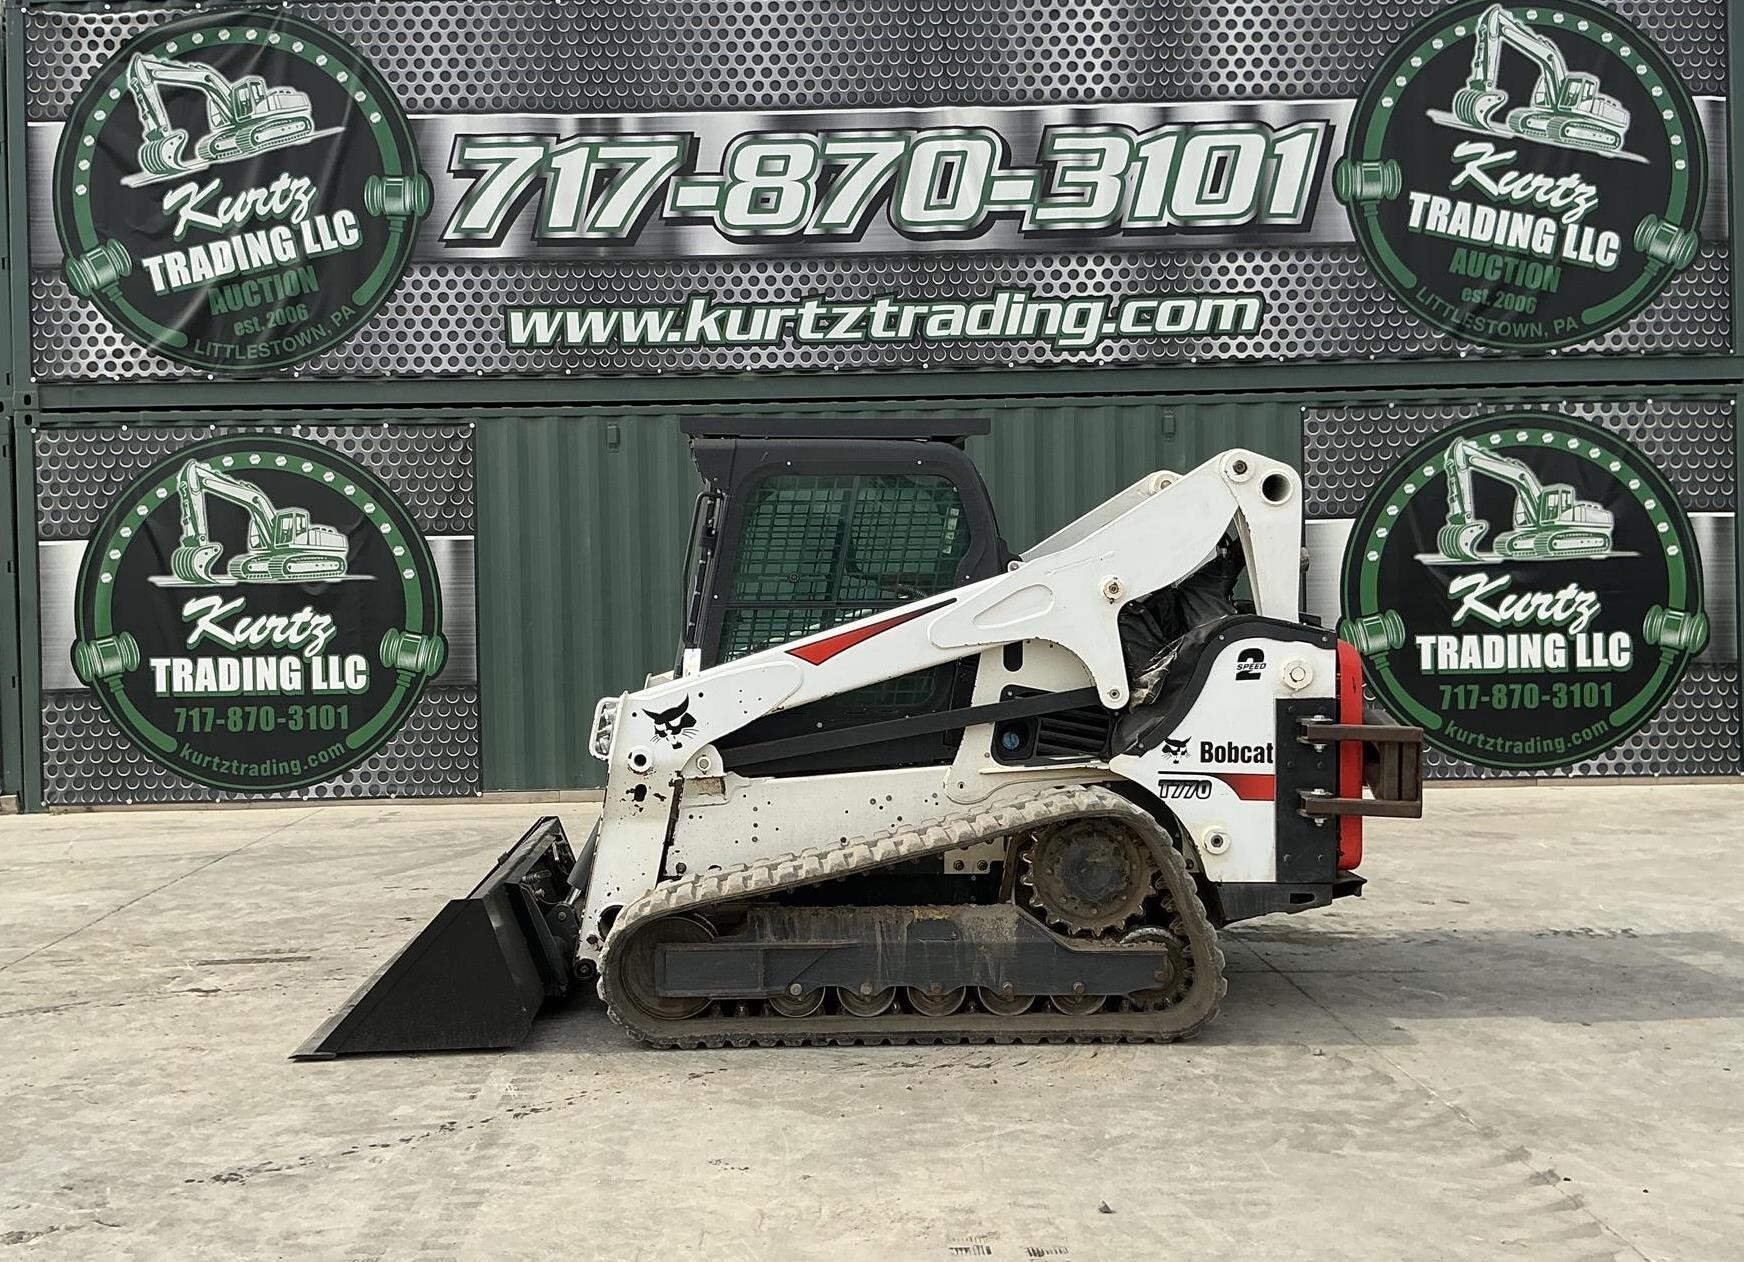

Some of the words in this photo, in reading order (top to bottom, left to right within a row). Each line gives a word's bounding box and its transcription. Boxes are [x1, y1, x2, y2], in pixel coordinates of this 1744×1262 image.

[448, 122, 1328, 241] 717-870-3101
[1450, 140, 1599, 224] Kurtz
[163, 172, 318, 239] Kurtz
[143, 226, 299, 294] TRADING
[301, 209, 361, 255] LLC
[1408, 191, 1557, 258] TRADING
[1562, 223, 1621, 271] LLC
[208, 265, 320, 316] AUCTION
[1449, 247, 1562, 293] AUCTION
[233, 317, 266, 337] est.
[266, 304, 310, 329] 2006
[507, 289, 1263, 347] www.kurtztrading.com
[1415, 285, 1549, 338] LITTLESTOWN,
[1553, 316, 1579, 334] PA
[1460, 287, 1492, 305] est.
[1495, 291, 1537, 314] 2006
[193, 327, 333, 361] LITTLESTOWN,
[330, 304, 357, 328] PA
[1448, 572, 1601, 637] Kurtz
[182, 595, 337, 661] Kurtz
[1235, 647, 1265, 681] 2
[1236, 662, 1267, 671] SPEED
[1415, 632, 1568, 674] TRADING
[1576, 631, 1634, 672] LLC
[150, 655, 304, 697] TRADING
[311, 654, 370, 695] LLC
[1439, 682, 1613, 711] 717-870-3101
[174, 704, 349, 733] 717-870-3101
[1444, 719, 1609, 754] kurtztrading.com
[179, 742, 346, 777] kurtztrading.com
[1200, 741, 1274, 764] Bobcat
[1158, 779, 1213, 800] T770
